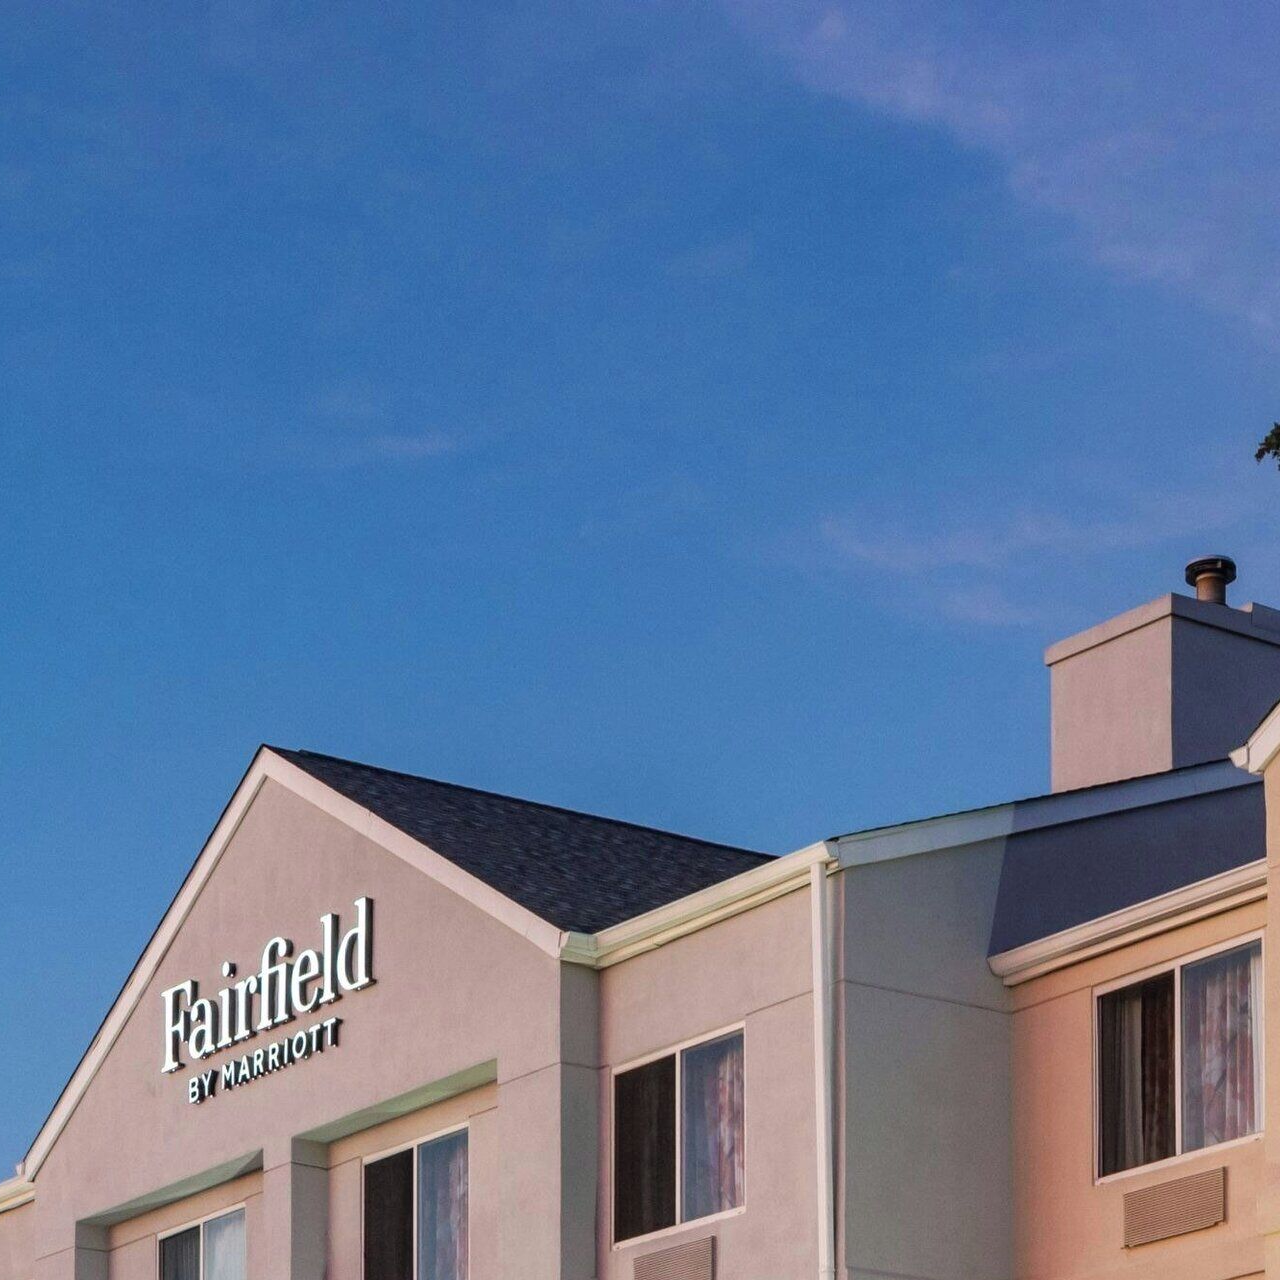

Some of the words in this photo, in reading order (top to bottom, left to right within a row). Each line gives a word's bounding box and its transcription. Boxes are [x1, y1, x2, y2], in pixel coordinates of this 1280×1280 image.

[161, 896, 375, 1074] Fairfield
[188, 1070, 218, 1104] BY
[221, 1017, 342, 1091] MARRIOTT
